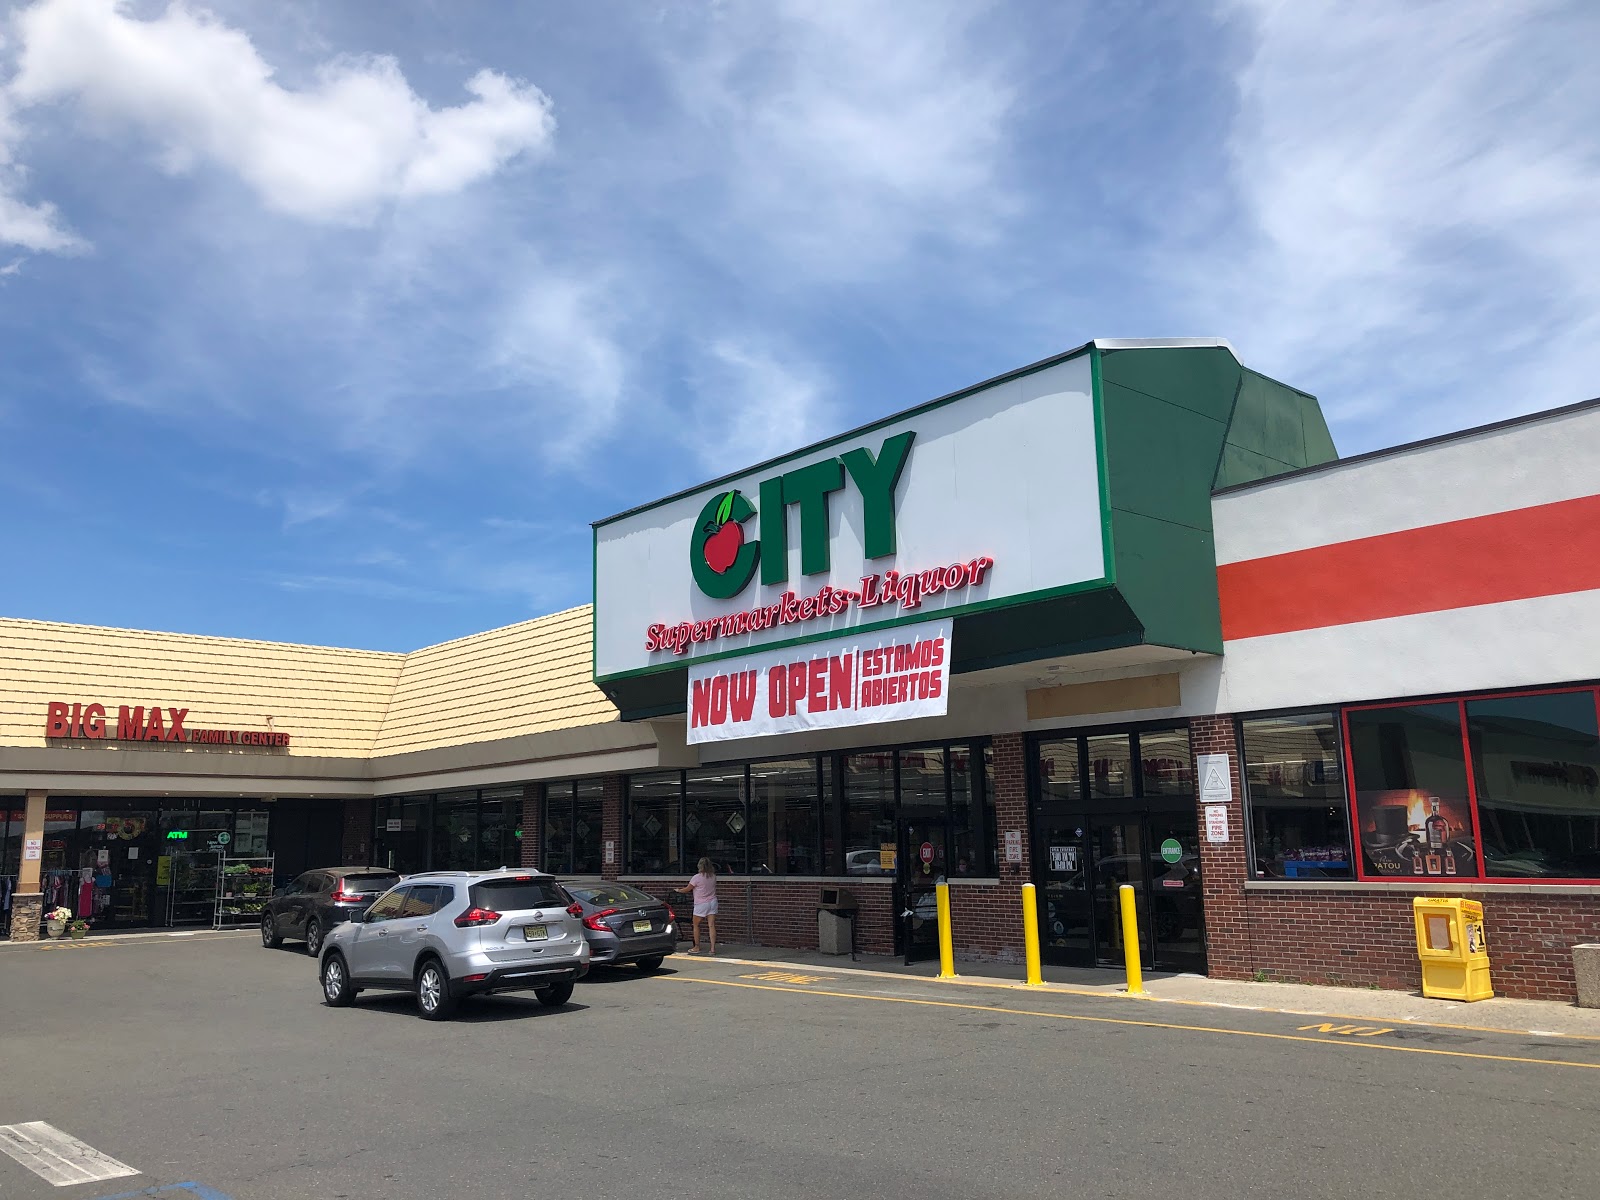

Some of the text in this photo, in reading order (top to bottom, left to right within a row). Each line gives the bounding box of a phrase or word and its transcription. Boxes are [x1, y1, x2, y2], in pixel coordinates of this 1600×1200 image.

[690, 430, 916, 599] CITY
[645, 556, 994, 655] Supermarkets Liquor
[862, 638, 944, 677] ESTAMOS
[691, 653, 853, 728] NOW OPEN
[861, 670, 942, 707] ABIERTOS
[47, 701, 290, 746] BIG MAX FAMILY CENTER
[166, 831, 189, 839] ATM
[922, 847, 931, 858] EXIT
[1162, 847, 1181, 855] ENTRANCE
